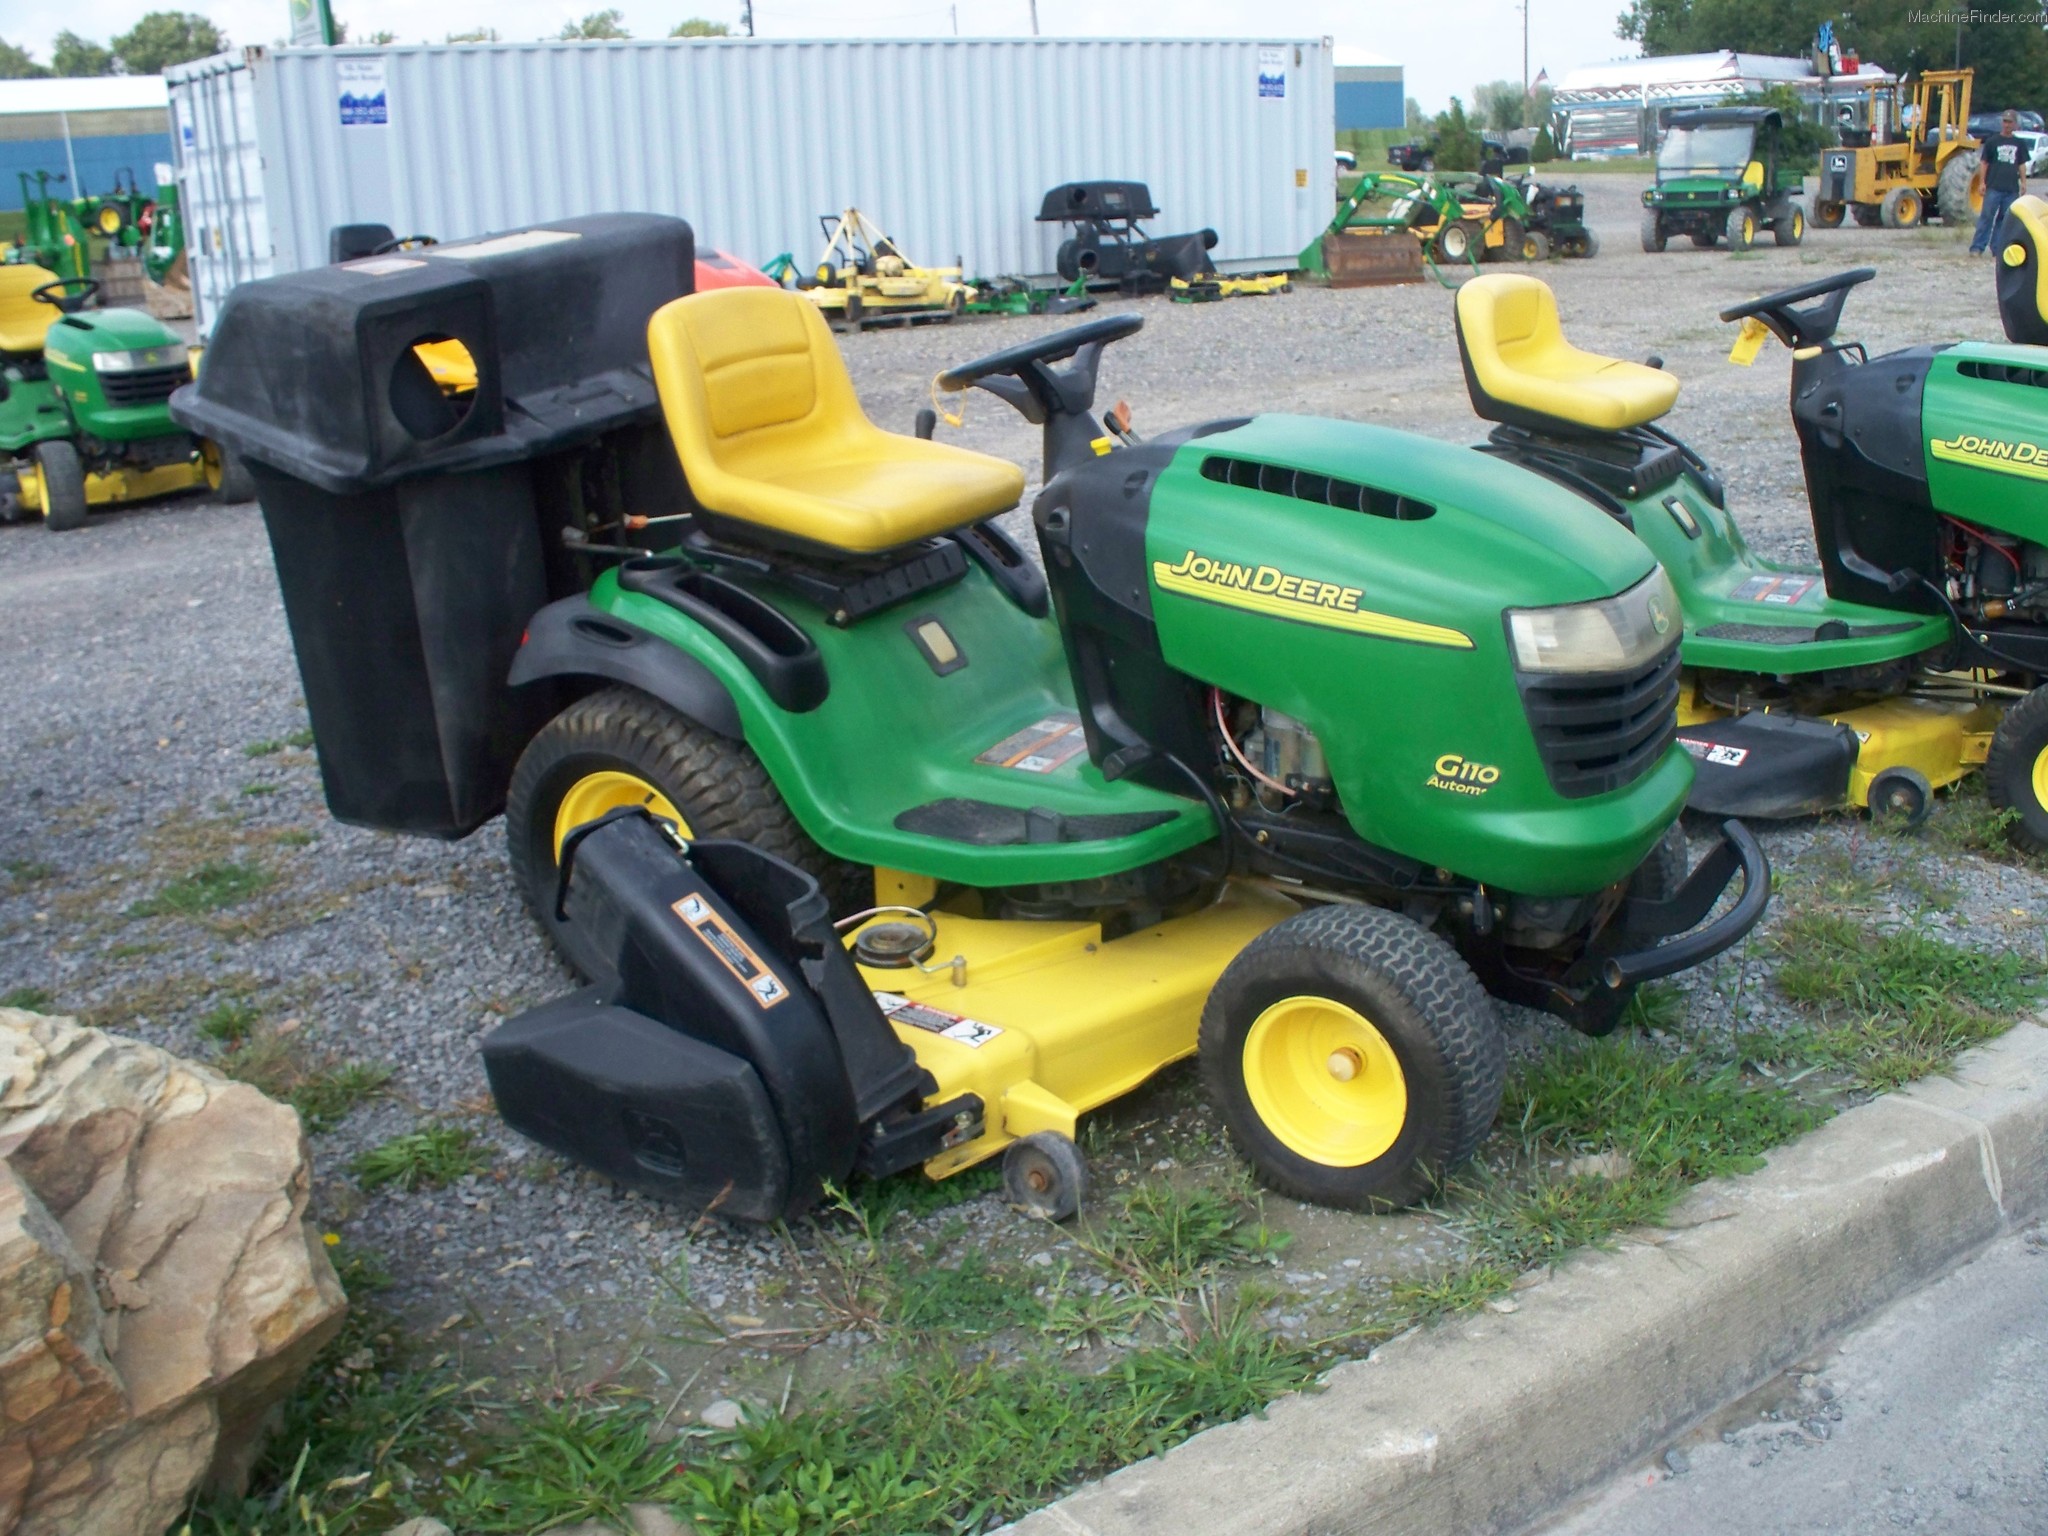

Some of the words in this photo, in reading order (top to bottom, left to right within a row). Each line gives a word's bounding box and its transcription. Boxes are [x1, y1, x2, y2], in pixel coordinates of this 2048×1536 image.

[1945, 434, 2014, 460] JOHN
[1170, 550, 1252, 589] JOHN
[1251, 565, 1365, 613] DEERE
[1435, 754, 1500, 784] G110
